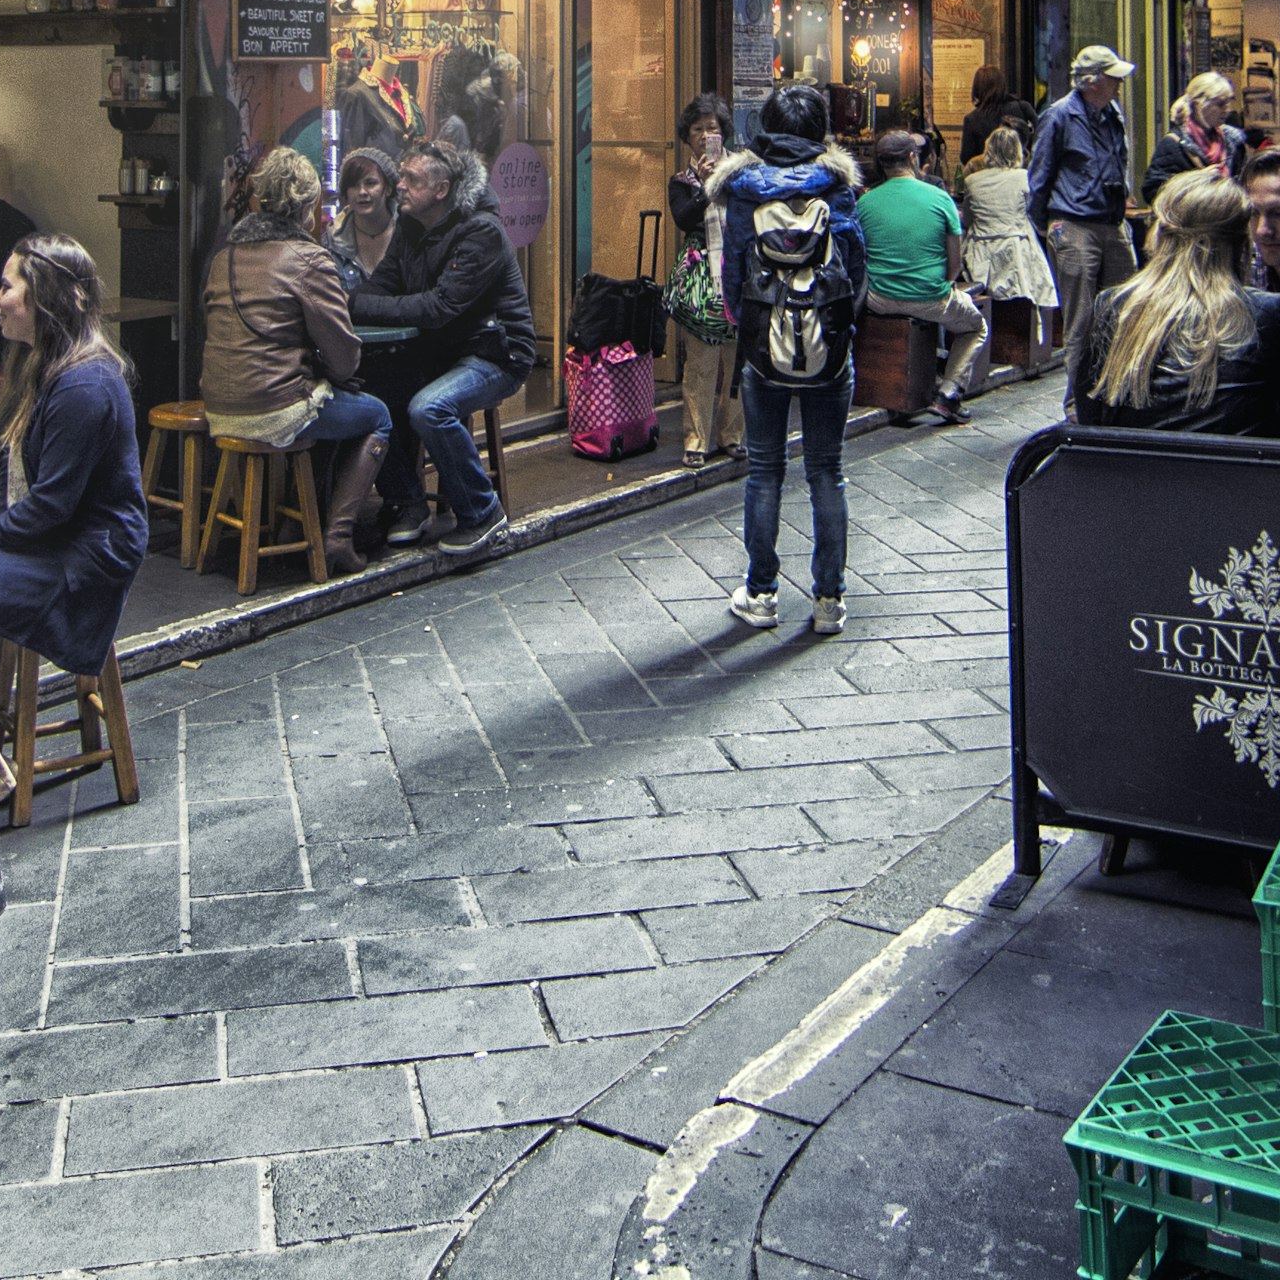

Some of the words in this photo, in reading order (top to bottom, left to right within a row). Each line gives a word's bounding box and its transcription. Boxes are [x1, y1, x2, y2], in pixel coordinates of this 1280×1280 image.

[248, 8, 287, 21] BEAUTIFUL
[290, 10, 313, 23] SWEET
[315, 12, 325, 23] OR
[248, 26, 280, 38] SAVOURY
[282, 28, 311, 40] CREPES
[243, 40, 263, 54] BON
[271, 42, 309, 54] APPETIT
[499, 158, 541, 175] online
[503, 174, 537, 189] store
[520, 214, 542, 228] open
[1161, 655, 1184, 671] LA
[1190, 659, 1276, 685] BOTTEGA
